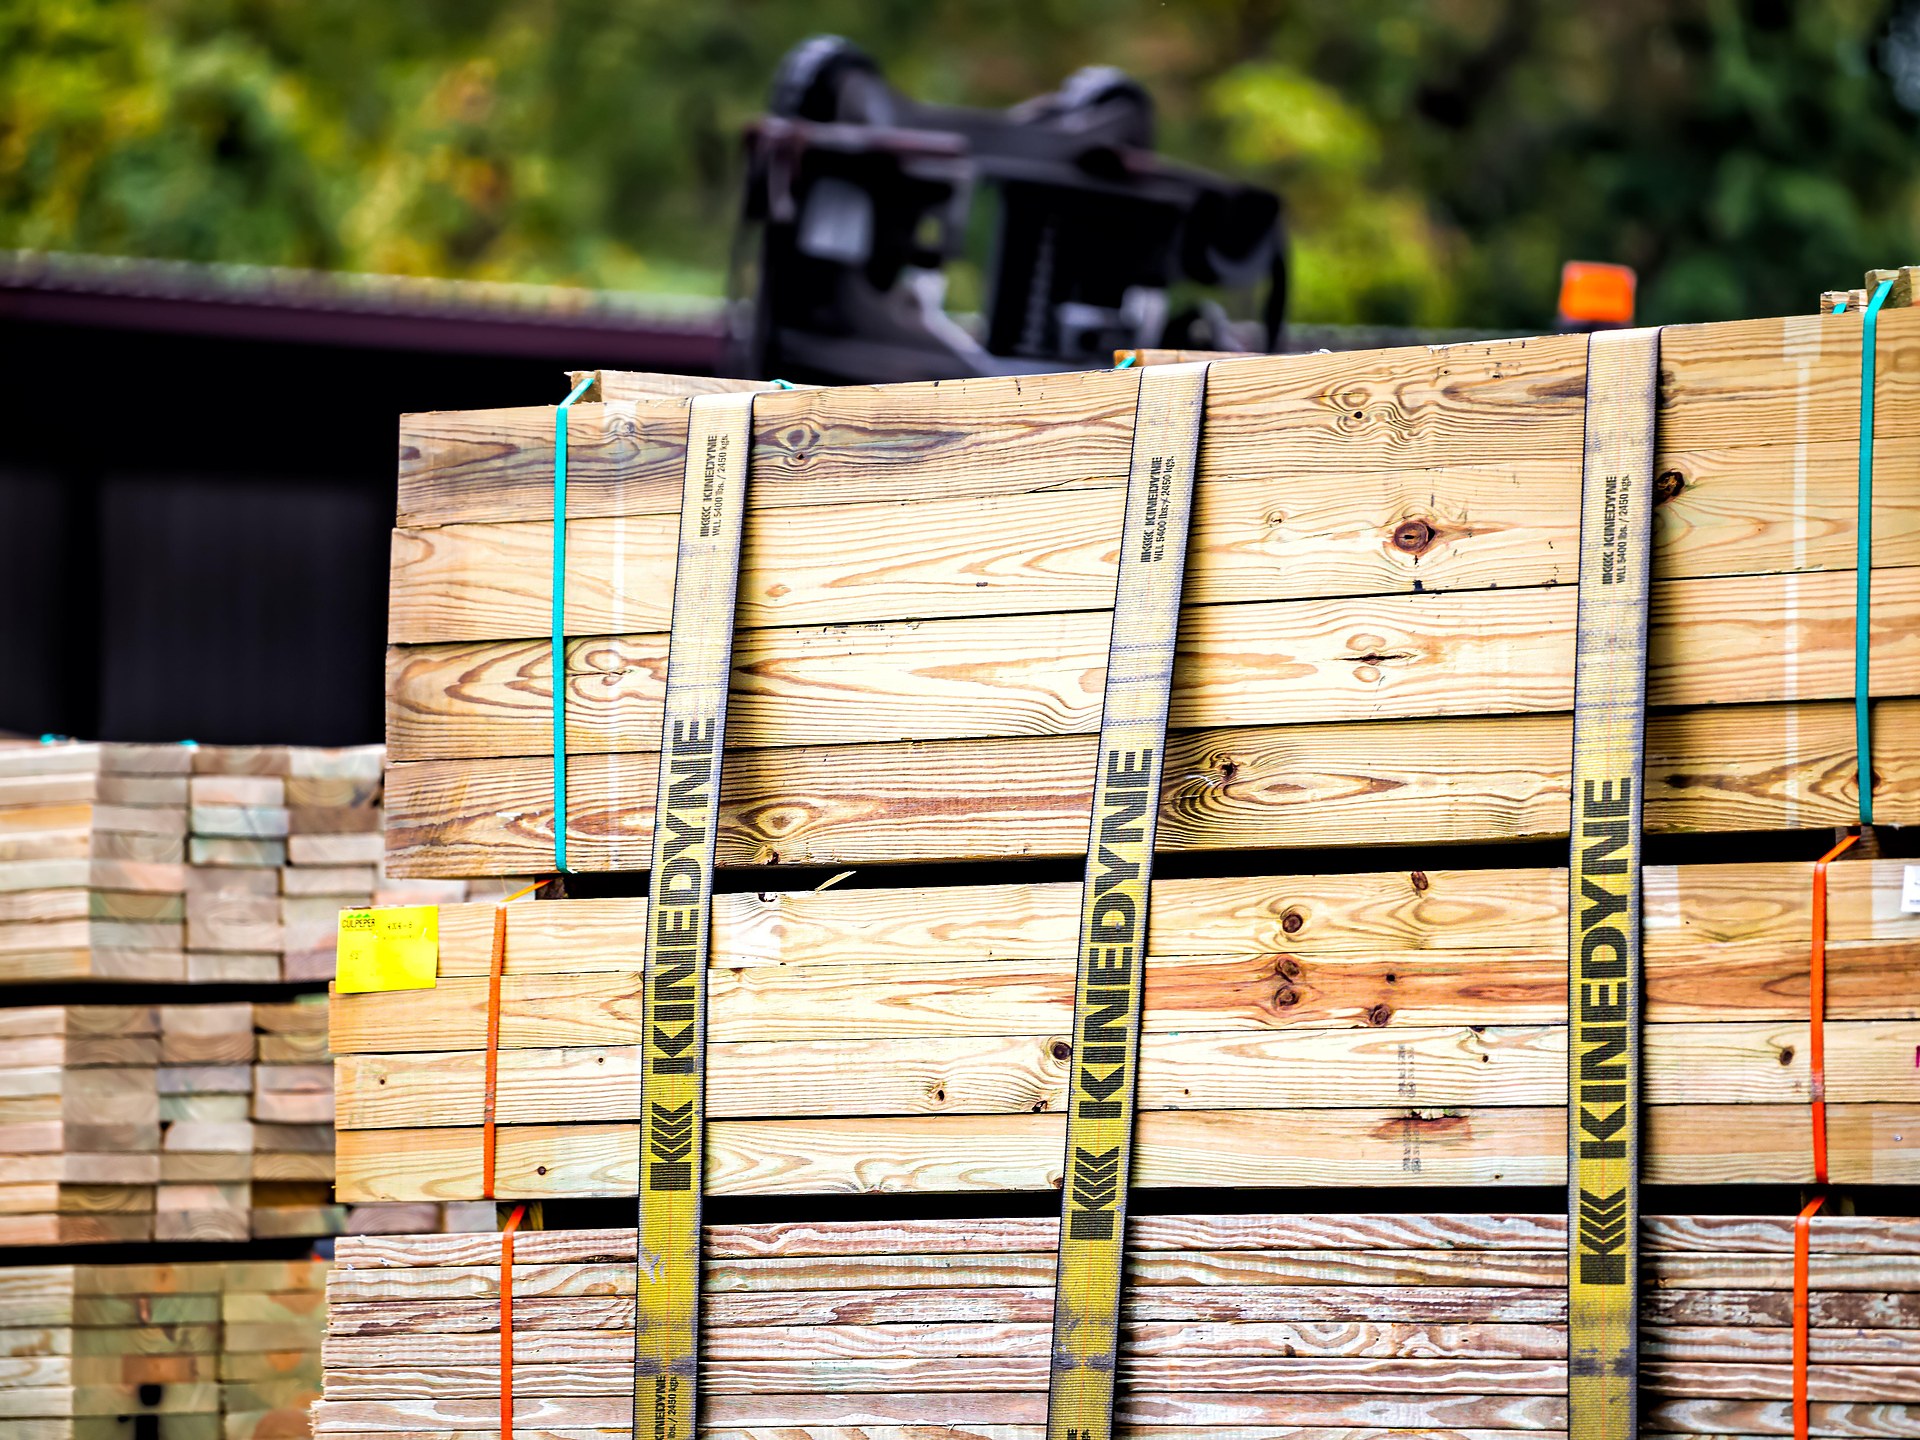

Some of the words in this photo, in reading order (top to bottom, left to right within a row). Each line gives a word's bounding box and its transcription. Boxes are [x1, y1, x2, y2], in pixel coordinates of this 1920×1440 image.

[703, 435, 717, 502] KINEDYNE
[717, 452, 727, 473] 2450
[1144, 457, 1163, 526] KINEDYNE
[1161, 474, 1172, 496] 2450
[713, 497, 723, 517] 5400
[1603, 476, 1617, 547] KINEDYNE
[1619, 494, 1628, 515] 2450
[712, 519, 722, 537] WLL
[1155, 521, 1167, 542] 5400
[1153, 545, 1165, 562] WLL
[1617, 541, 1627, 563] 5400
[1616, 566, 1626, 584] WLL
[653, 719, 715, 1074] KINEDYNE
[1078, 750, 1152, 1118] KINEDYNE
[1580, 777, 1630, 1158] KINEDYNE
[668, 1394, 677, 1416] 2450
